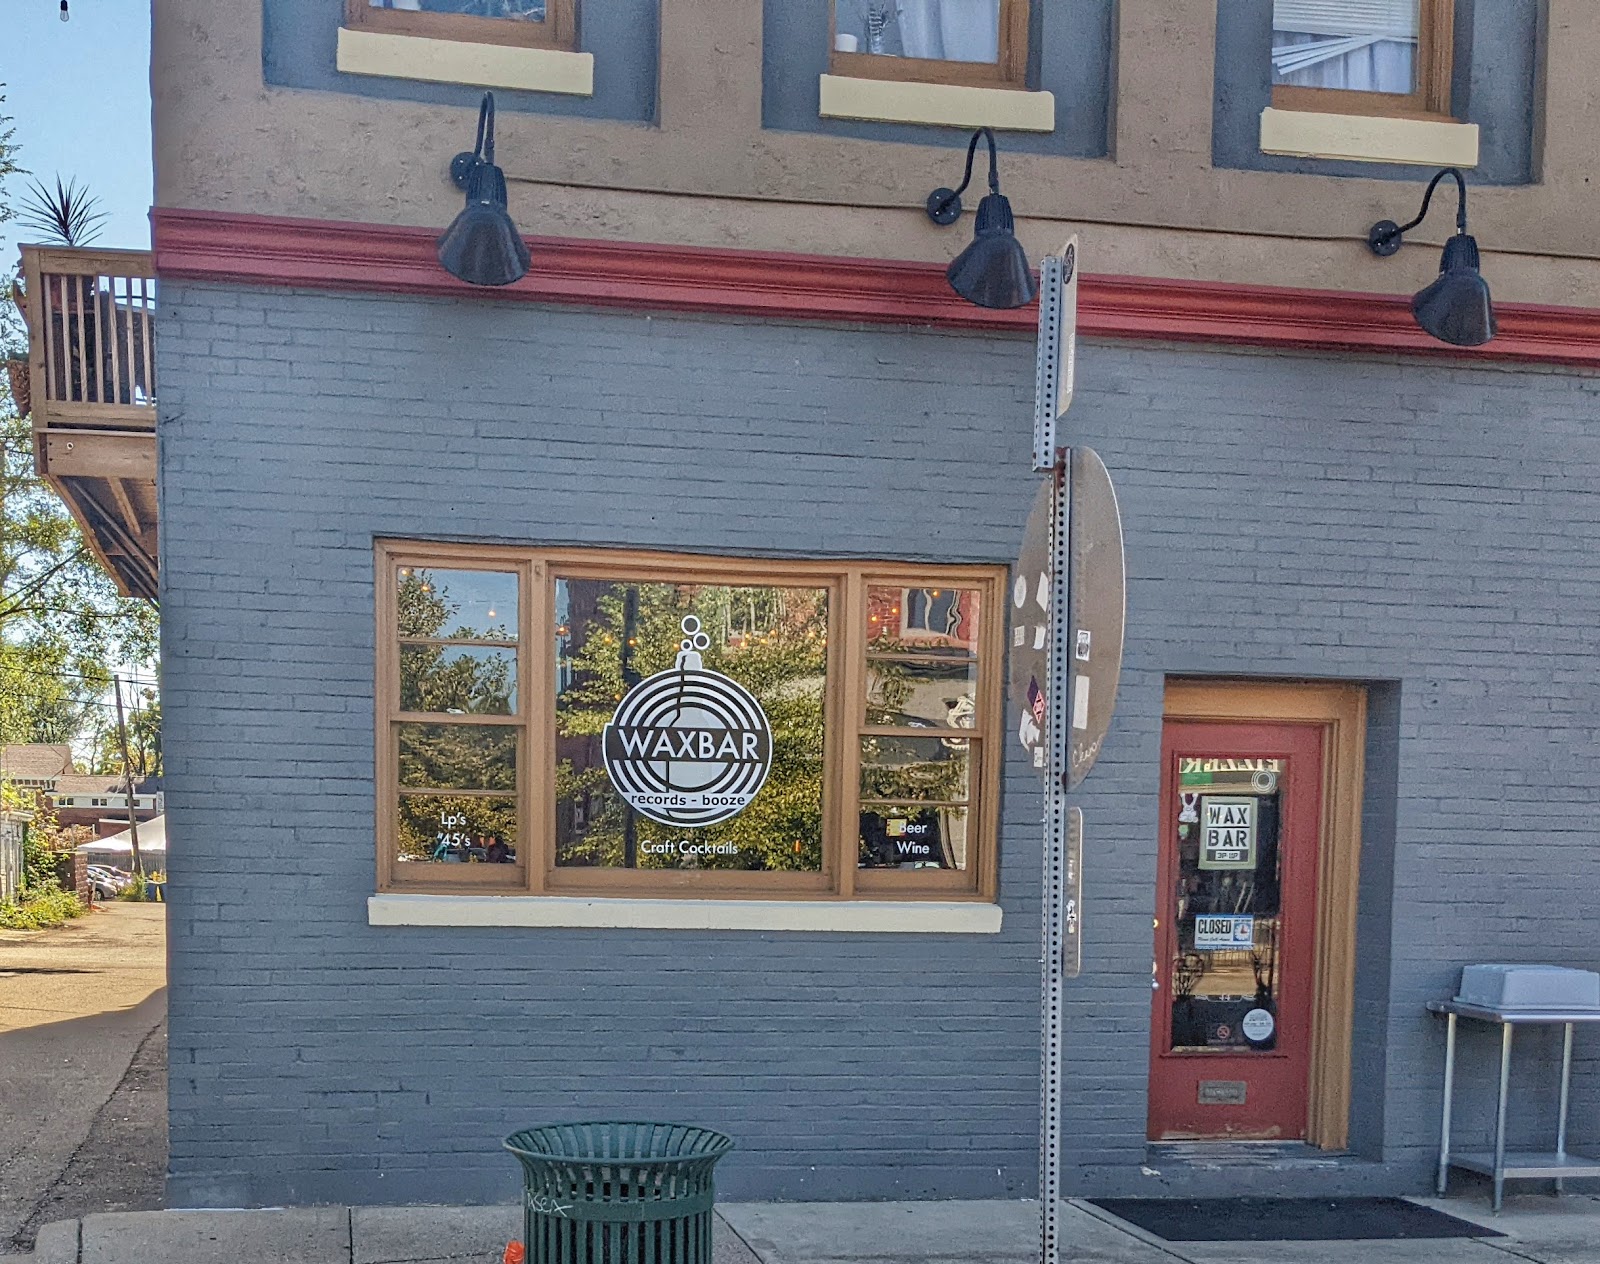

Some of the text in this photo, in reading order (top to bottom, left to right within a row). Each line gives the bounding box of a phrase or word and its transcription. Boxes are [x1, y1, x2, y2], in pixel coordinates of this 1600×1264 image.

[618, 728, 760, 760] WAXBAR
[631, 793, 687, 806] records
[702, 794, 745, 806] booze
[441, 812, 467, 829] Lp's
[1209, 807, 1248, 825] WAX
[1208, 829, 1247, 847] BAR
[640, 840, 738, 855] Craft Cocktails
[896, 840, 930, 854] Wine
[1198, 919, 1232, 934] CLOSED
